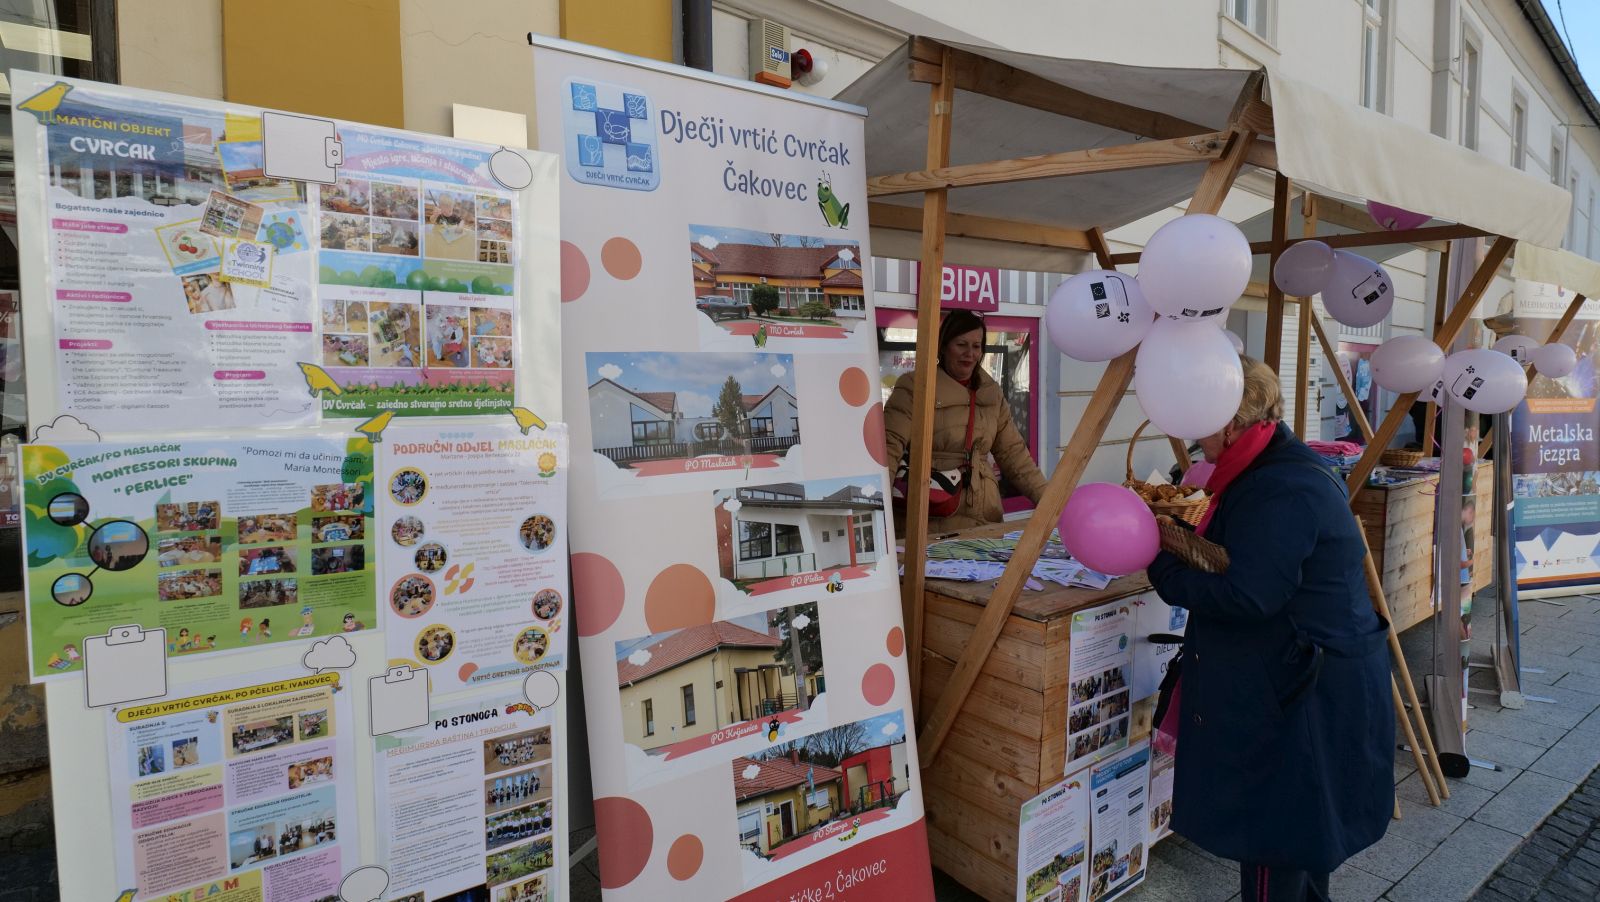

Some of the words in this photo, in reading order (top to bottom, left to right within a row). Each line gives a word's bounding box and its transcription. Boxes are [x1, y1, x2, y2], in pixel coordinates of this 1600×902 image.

[56, 113, 117, 131] MATIČNI
[121, 123, 172, 138] OBJEKT
[661, 109, 724, 148] Dječji
[731, 127, 778, 155] vrtić
[783, 132, 851, 166] Cvrčak
[69, 135, 156, 161] CVRČAK
[362, 156, 389, 169] Mjesto
[411, 155, 437, 166] učenja
[586, 169, 605, 180] DJEČJI
[606, 172, 624, 183] VRTIĆ
[625, 174, 650, 186] CVRČAK
[723, 159, 807, 201] Čakovec
[55, 203, 101, 213] Bogatstvo
[102, 206, 123, 215] naše
[124, 208, 165, 218] zajednice
[940, 267, 995, 305] BIPA
[323, 400, 336, 410] DV
[336, 399, 366, 410] Cvrčak
[410, 400, 447, 409] stvaramo
[448, 400, 473, 409] sretno
[474, 399, 512, 410] djetinjstvo
[1529, 423, 1593, 443] Metalska
[498, 437, 557, 450] MASLAČAK
[38, 470, 54, 485] DV
[55, 450, 122, 477] CVRČAK/PO
[124, 443, 182, 457] MASLAČAK
[242, 446, 282, 458] "Pomozi
[284, 451, 297, 459] mi
[299, 451, 310, 460] da
[313, 452, 342, 462] učinim
[685, 461, 699, 471] PO
[700, 457, 737, 469] Maslačak
[1539, 444, 1581, 466] jezgra
[91, 457, 181, 484] MONTESSORI
[183, 456, 238, 468] SKUPINA
[284, 463, 311, 473] Maria
[313, 464, 361, 476] Montessori
[125, 474, 194, 496] PERLICE"
[790, 576, 802, 587] PO
[127, 706, 160, 719] DJEČJI
[162, 700, 190, 712] VRTIĆ
[193, 693, 234, 709] CVRČAK,
[236, 690, 248, 699] PO
[250, 683, 288, 697] PČELICE,
[289, 675, 331, 689] IVANOVEC
[435, 717, 448, 731] PO
[451, 708, 499, 727] STONOGA
[442, 731, 475, 746] BAŠTINA
[710, 732, 724, 745] PO
[812, 829, 824, 841] PO
[824, 881, 835, 900] 2,
[836, 859, 887, 893] Čakovec
